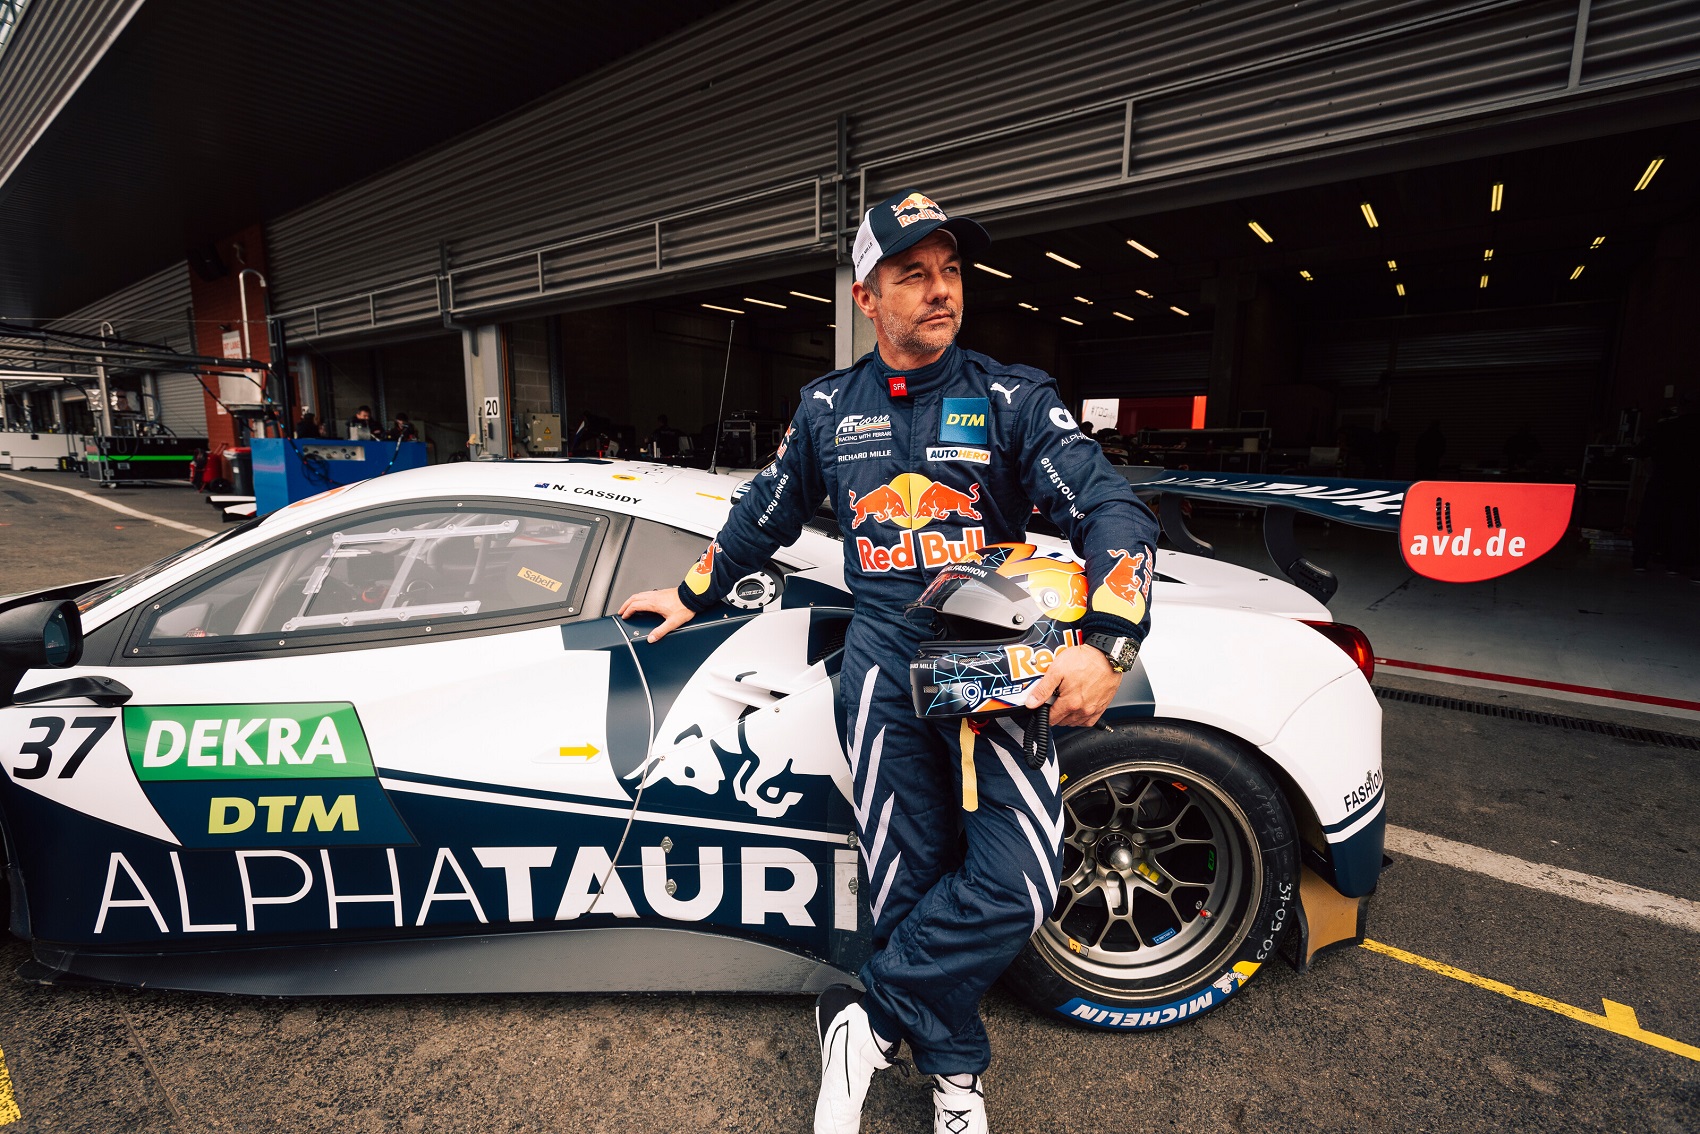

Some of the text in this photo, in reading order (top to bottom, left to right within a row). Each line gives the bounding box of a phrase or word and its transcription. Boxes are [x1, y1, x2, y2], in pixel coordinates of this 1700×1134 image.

[897, 209, 929, 228] Red
[893, 383, 906, 391] SFR
[486, 400, 498, 415] 20
[945, 413, 985, 427] DTM
[838, 450, 892, 462] RICHARD MILLE
[930, 449, 989, 462] AUTOHERO
[552, 484, 642, 505] N. CASSIDY
[765, 499, 778, 515] YOU
[774, 473, 789, 500] WINGS
[856, 526, 986, 573] Red Bull
[1410, 527, 1526, 557] avd.de
[523, 570, 556, 589] Sabelt
[952, 564, 988, 578] FASHION
[982, 684, 1023, 699] LOEB
[13, 716, 117, 780] 37
[142, 716, 347, 768] DEKRA
[1343, 766, 1383, 813] FASHION
[208, 794, 360, 834] DTM
[1256, 882, 1292, 960] 37-09-03
[1071, 991, 1213, 1027] MICHELIN
